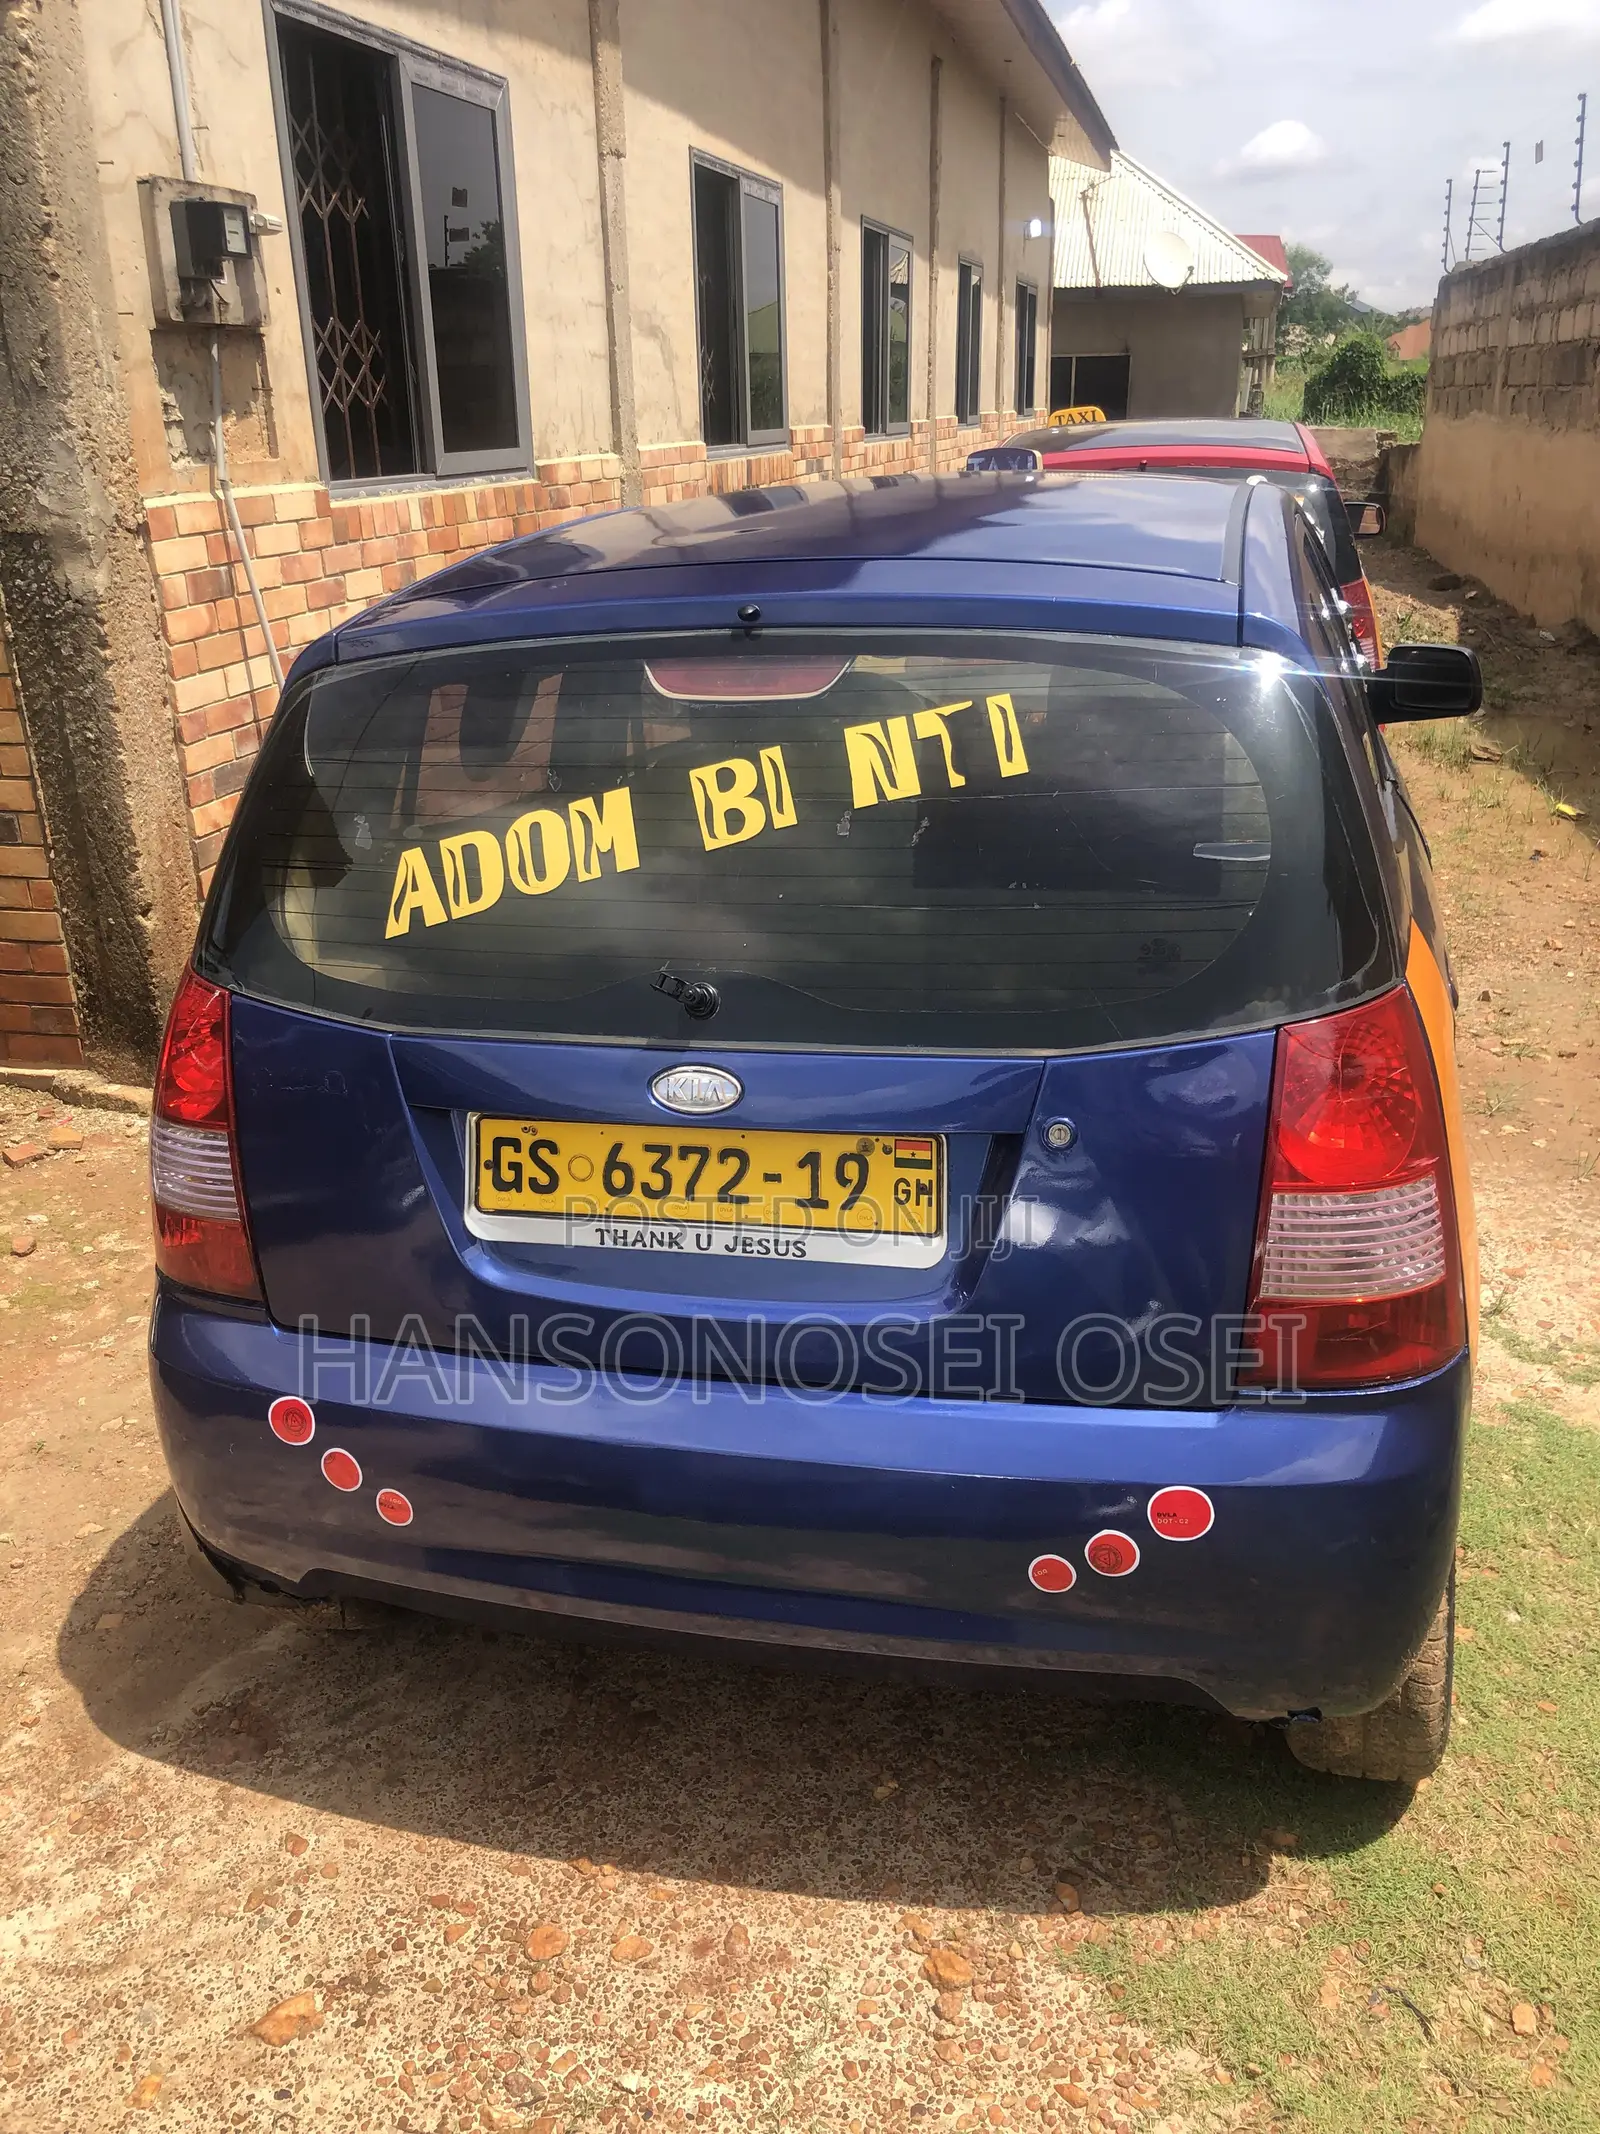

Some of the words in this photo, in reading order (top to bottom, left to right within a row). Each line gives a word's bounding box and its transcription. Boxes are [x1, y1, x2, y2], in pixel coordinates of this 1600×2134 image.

[1054, 409, 1098, 426] TAXI
[384, 786, 641, 939] ADOM
[688, 745, 798, 851] BI
[665, 1077, 726, 1103] KIA
[492, 1136, 560, 1195] GS
[602, 1140, 870, 1211] 6372-19
[893, 1177, 934, 1208] GH
[595, 1228, 684, 1250] THANK
[695, 1233, 713, 1252] U
[724, 1235, 807, 1259] JESUS
